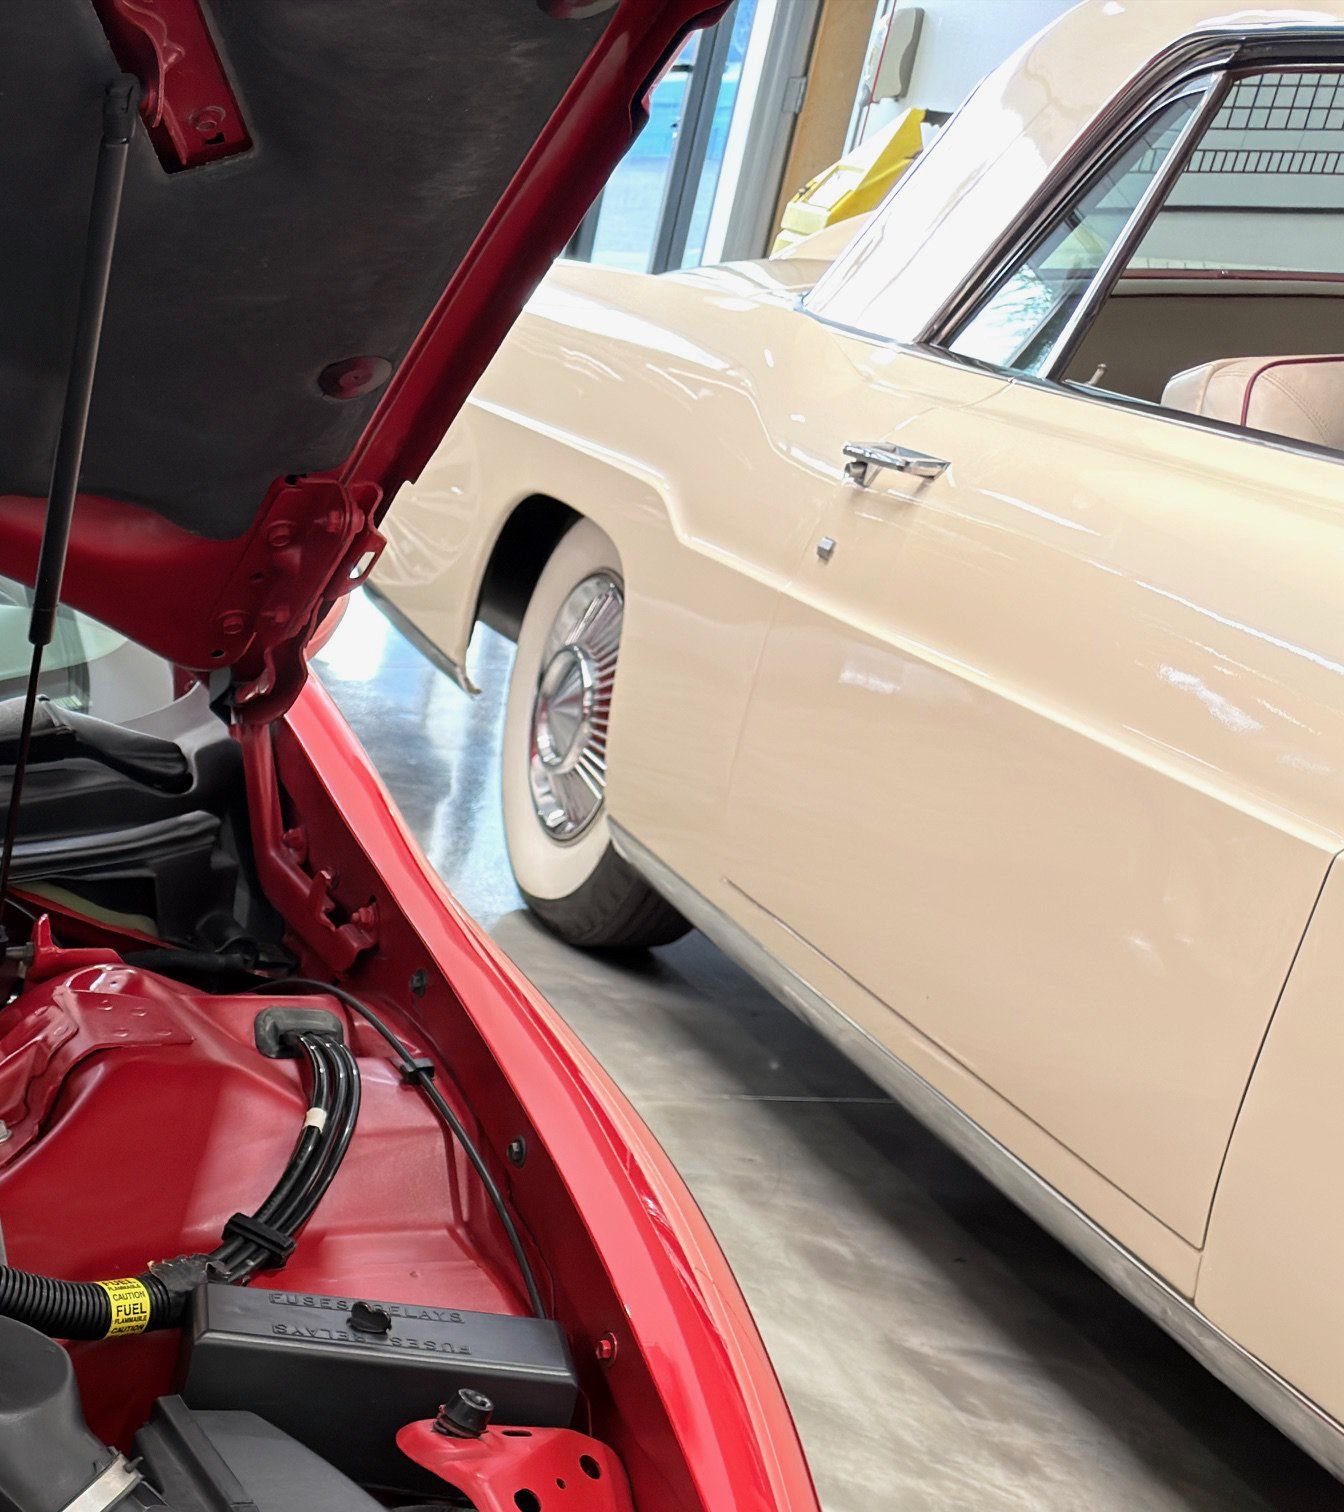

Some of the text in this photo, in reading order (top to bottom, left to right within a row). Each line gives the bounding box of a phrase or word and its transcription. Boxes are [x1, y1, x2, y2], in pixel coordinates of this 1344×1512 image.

[113, 1291, 145, 1301] CAUTION
[270, 1293, 349, 1310] FUSES
[116, 1303, 146, 1317] FUEL
[111, 1325, 144, 1334] CAUTION
